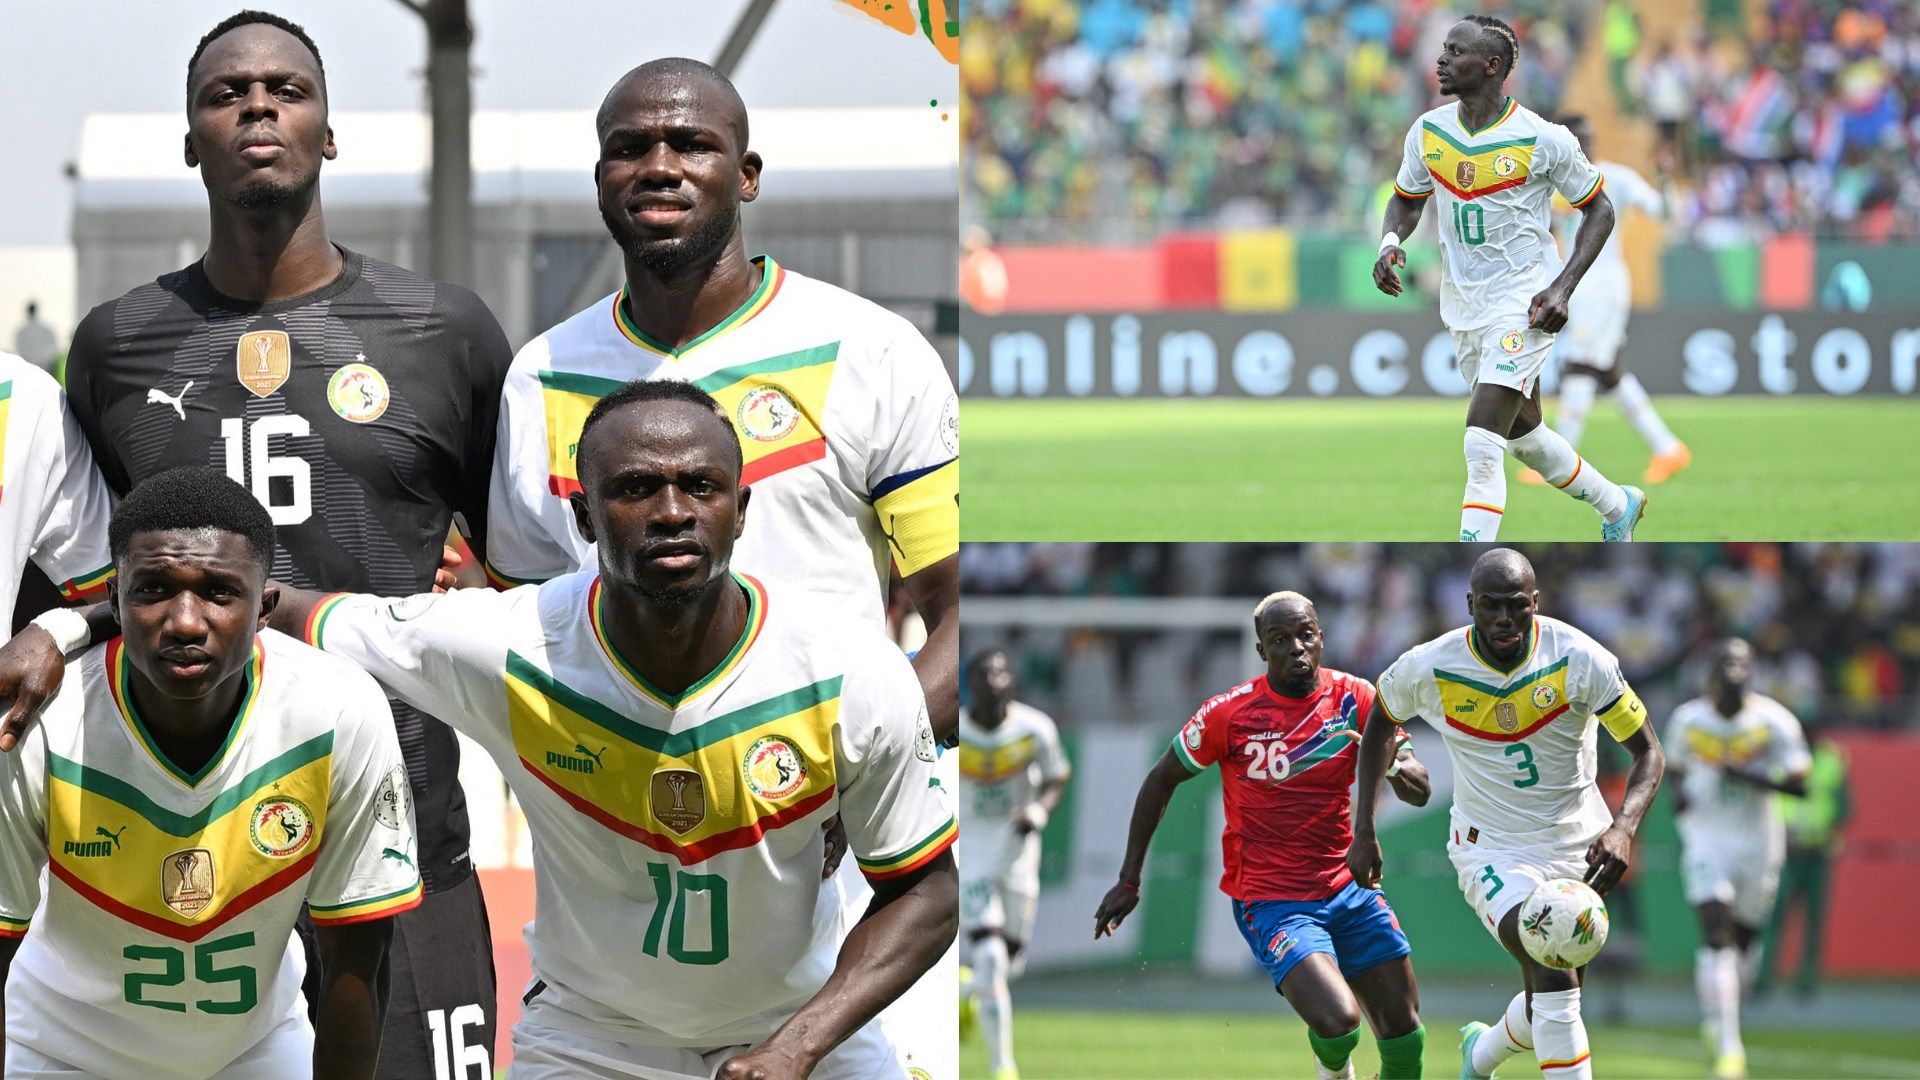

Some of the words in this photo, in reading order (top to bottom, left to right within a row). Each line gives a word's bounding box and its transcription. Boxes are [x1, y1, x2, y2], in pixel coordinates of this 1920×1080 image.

[1452, 201, 1486, 245] 10
[959, 314, 1565, 396] nline.co
[1495, 363, 1515, 373] PUMA
[221, 414, 312, 526] 16
[1455, 705, 1475, 713] PUMA
[546, 751, 594, 774] PUMA
[1244, 740, 1290, 780] 26
[1504, 742, 1540, 788] 3
[64, 841, 112, 858] PUMA
[642, 862, 730, 966] 10
[123, 931, 258, 1015] 25
[427, 1003, 492, 1080] 16
